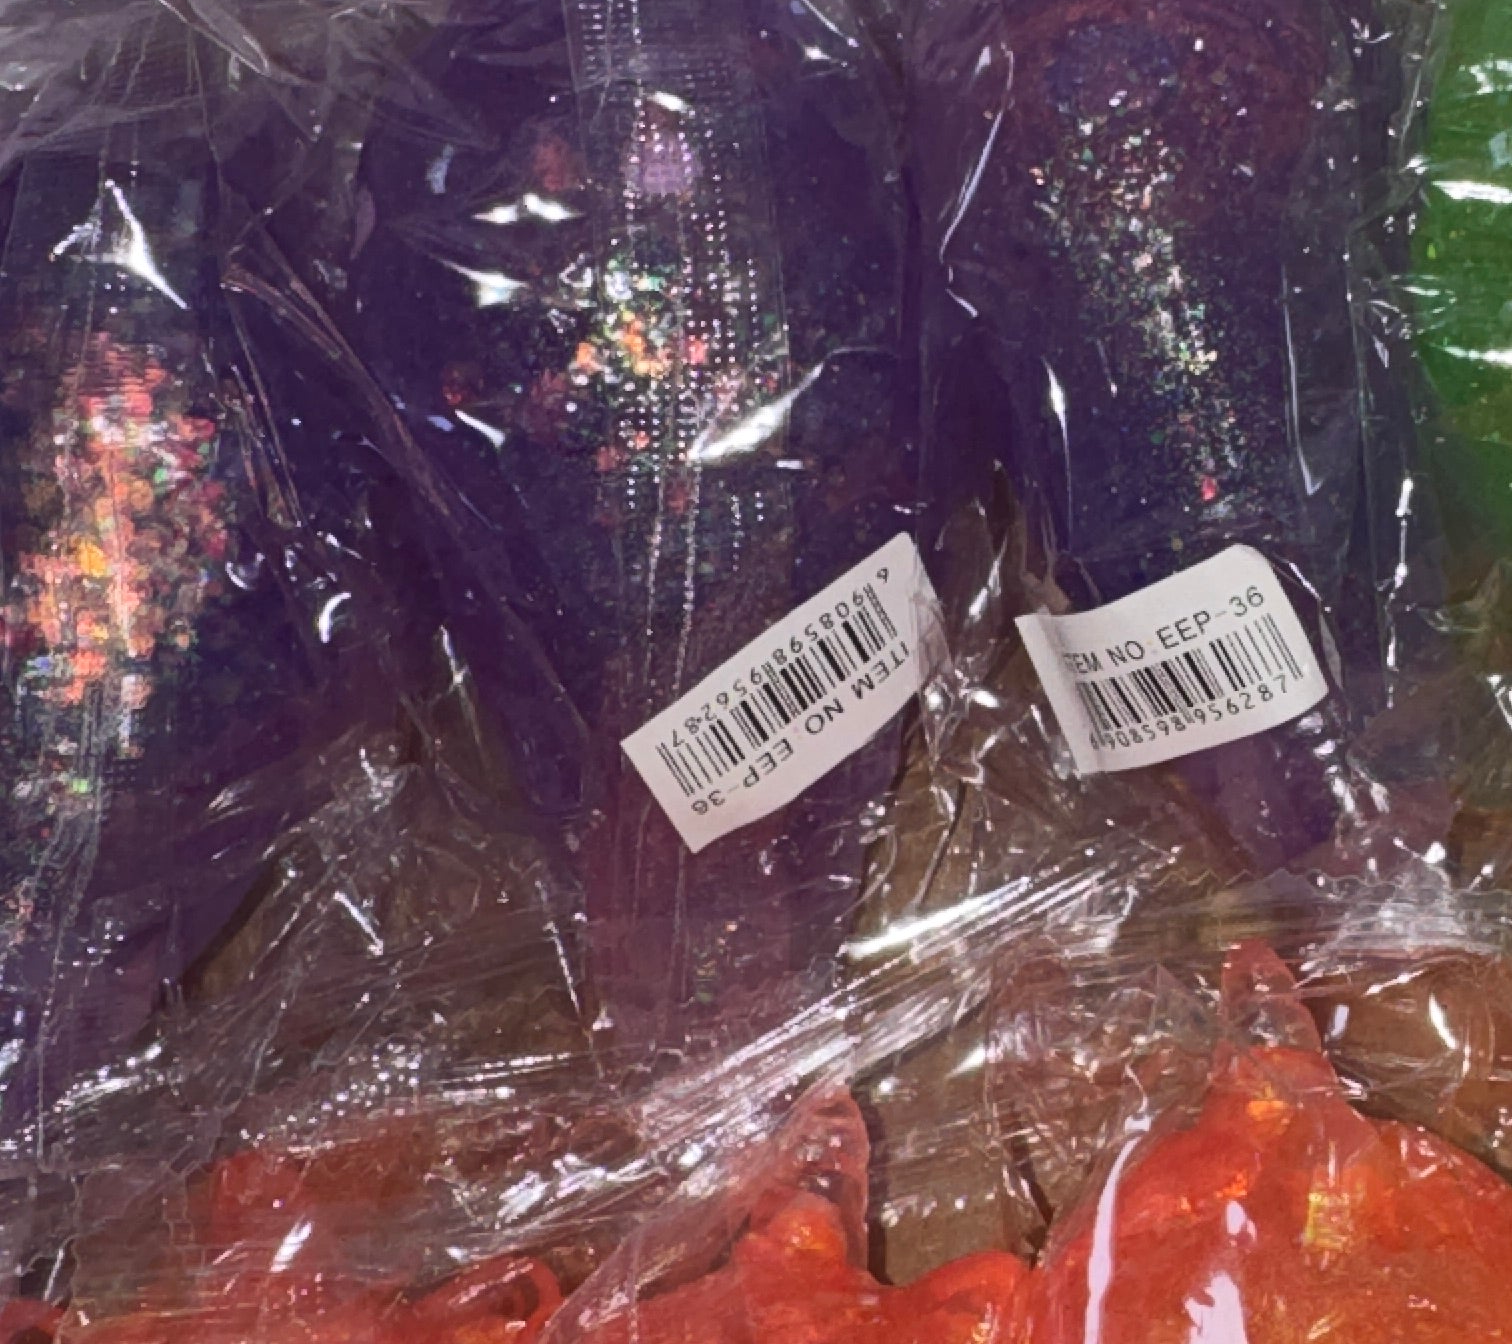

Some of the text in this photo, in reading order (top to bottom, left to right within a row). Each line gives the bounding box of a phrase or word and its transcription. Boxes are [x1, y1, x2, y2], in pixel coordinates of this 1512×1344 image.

[1156, 584, 1266, 651] EEP-36
[850, 640, 911, 701] ITEM
[690, 737, 795, 817] EEP-36
